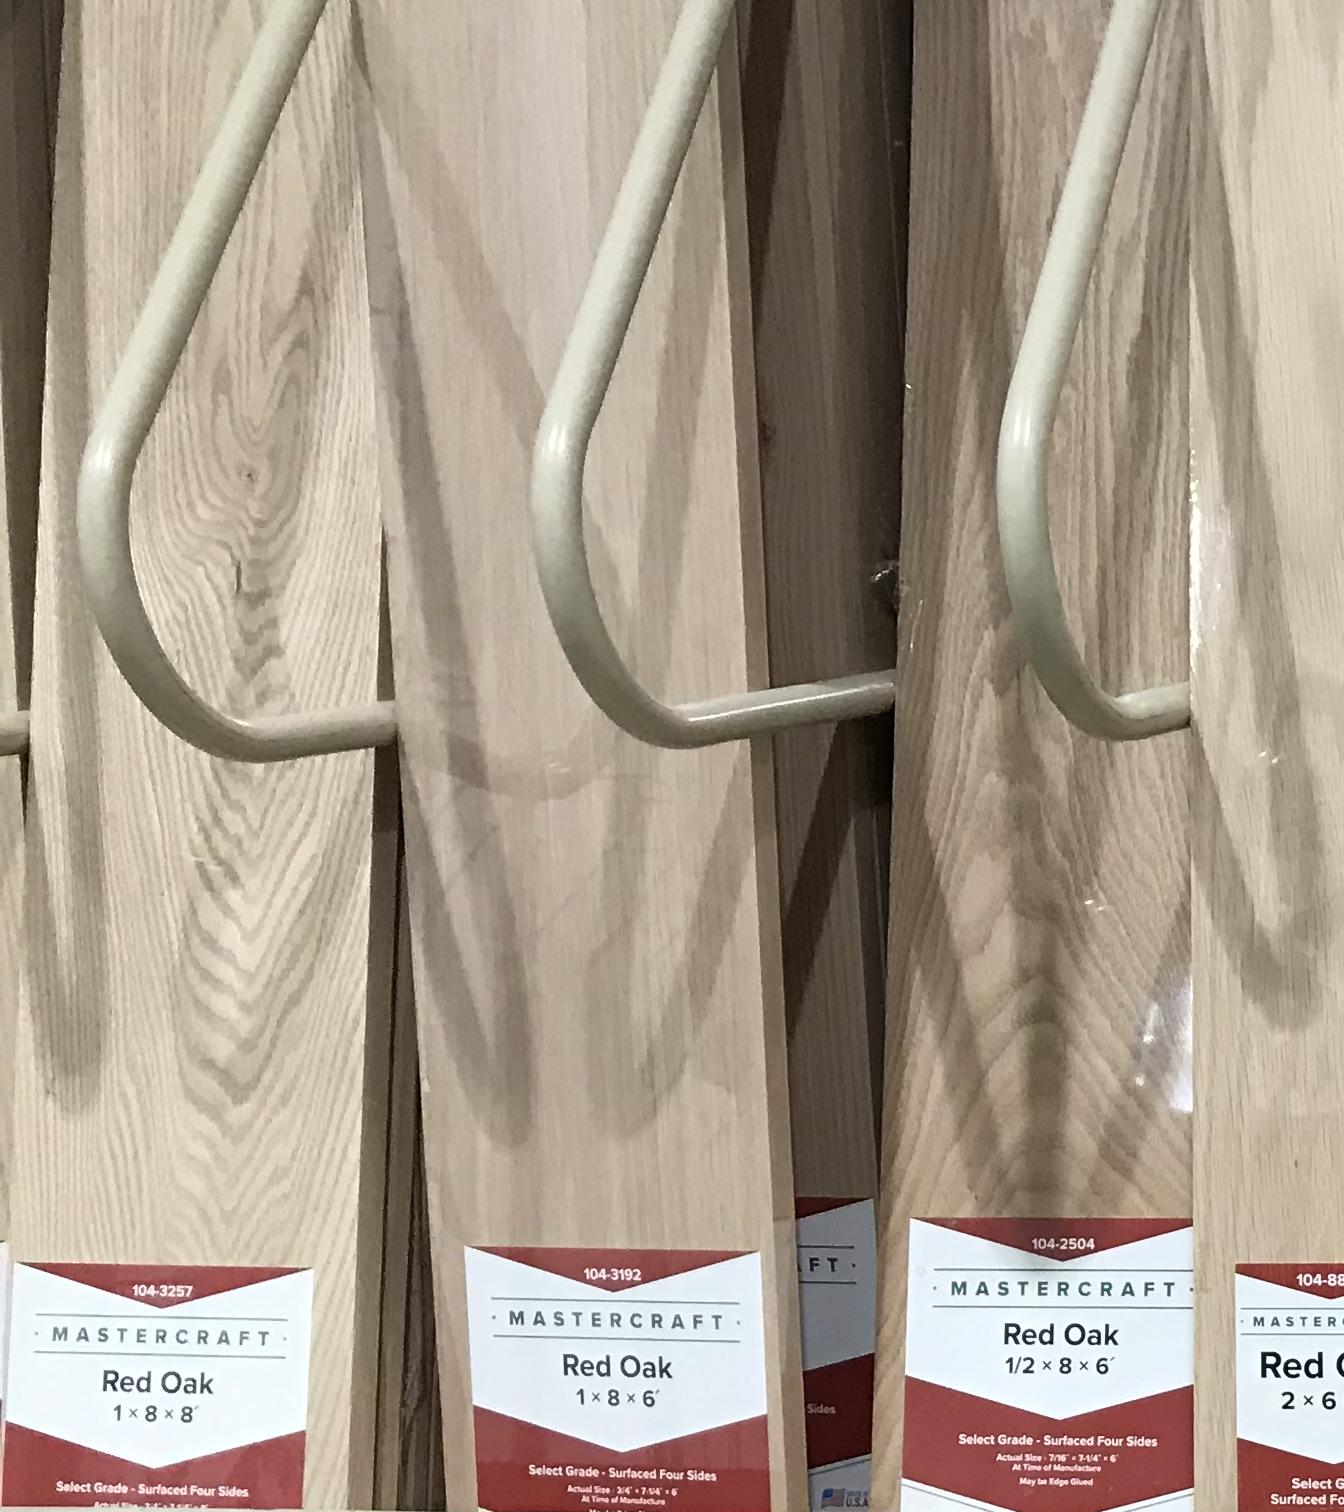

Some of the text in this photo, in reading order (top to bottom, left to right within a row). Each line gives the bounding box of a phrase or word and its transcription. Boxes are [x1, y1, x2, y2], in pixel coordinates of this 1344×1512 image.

[1032, 1238, 1095, 1250] 104-2504
[584, 1268, 641, 1281] 104-3192
[132, 1285, 193, 1298] 104-3257
[951, 1281, 1175, 1297] MASTERCRAFT
[509, 1310, 723, 1329] MASTERCRAFT
[52, 1327, 270, 1346] MASTERCRAFT
[1004, 1323, 1119, 1346] Red Oak
[563, 1354, 672, 1379] Red Oak
[1261, 1352, 1323, 1378] Red
[103, 1370, 214, 1394] Red Oak
[958, 1434, 1158, 1447] Select Grade Surfaced Four Sides
[528, 1464, 716, 1481] Select Grade Surfaced Four Sides
[56, 1481, 249, 1497] Select Grade Surfaced Four Sides
[1291, 1478, 1332, 1489] Select
[1270, 1494, 1326, 1505] Surfaced
